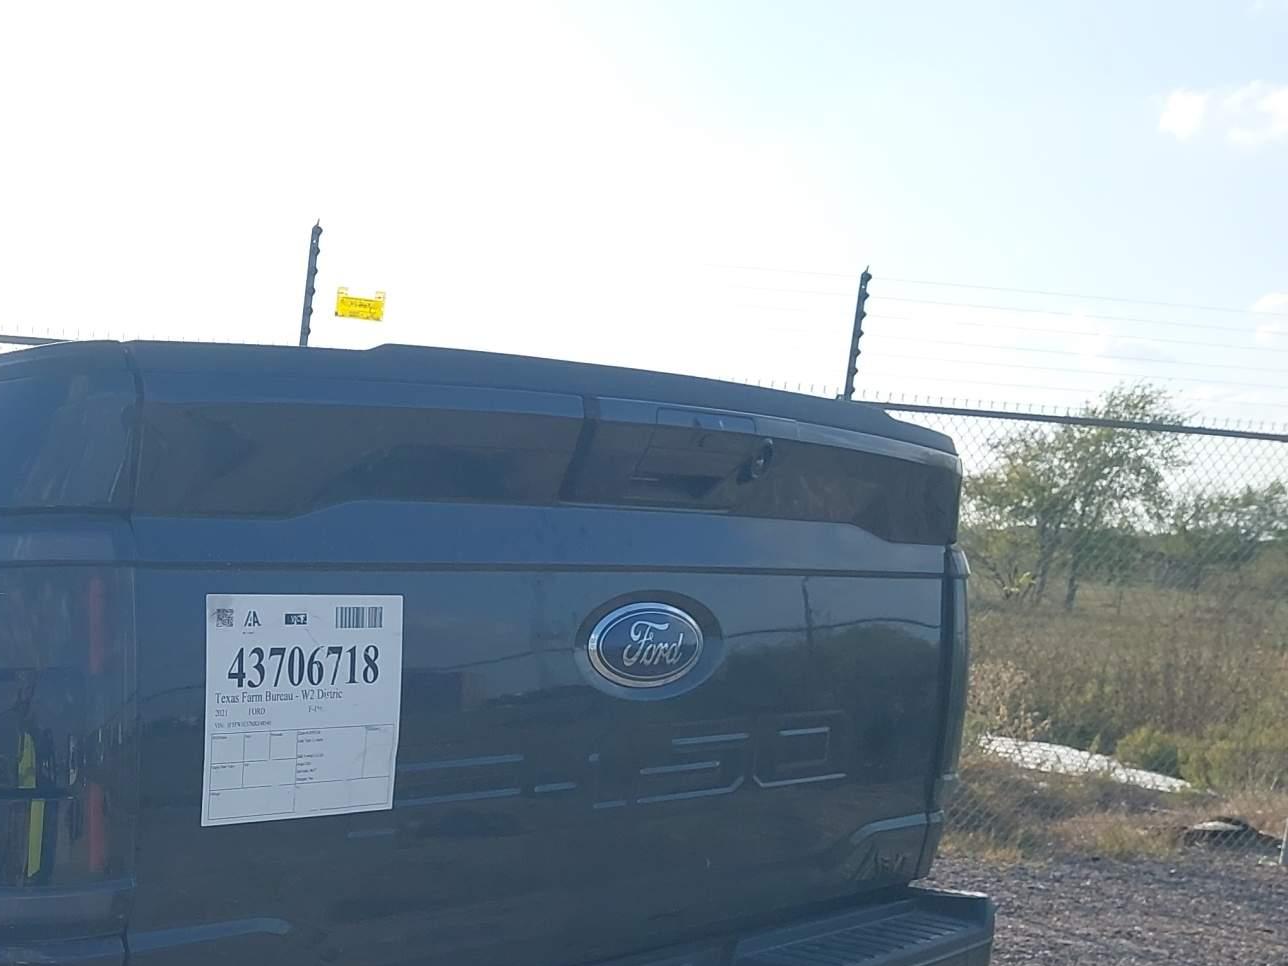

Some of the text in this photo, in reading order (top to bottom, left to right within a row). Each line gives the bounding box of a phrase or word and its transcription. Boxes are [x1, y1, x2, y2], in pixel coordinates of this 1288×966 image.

[623, 620, 684, 667] Ford
[227, 644, 380, 688] 43706718
[215, 692, 240, 705] Texas
[241, 691, 263, 703] Farm
[265, 690, 294, 702] Bureau
[301, 689, 315, 701] W2
